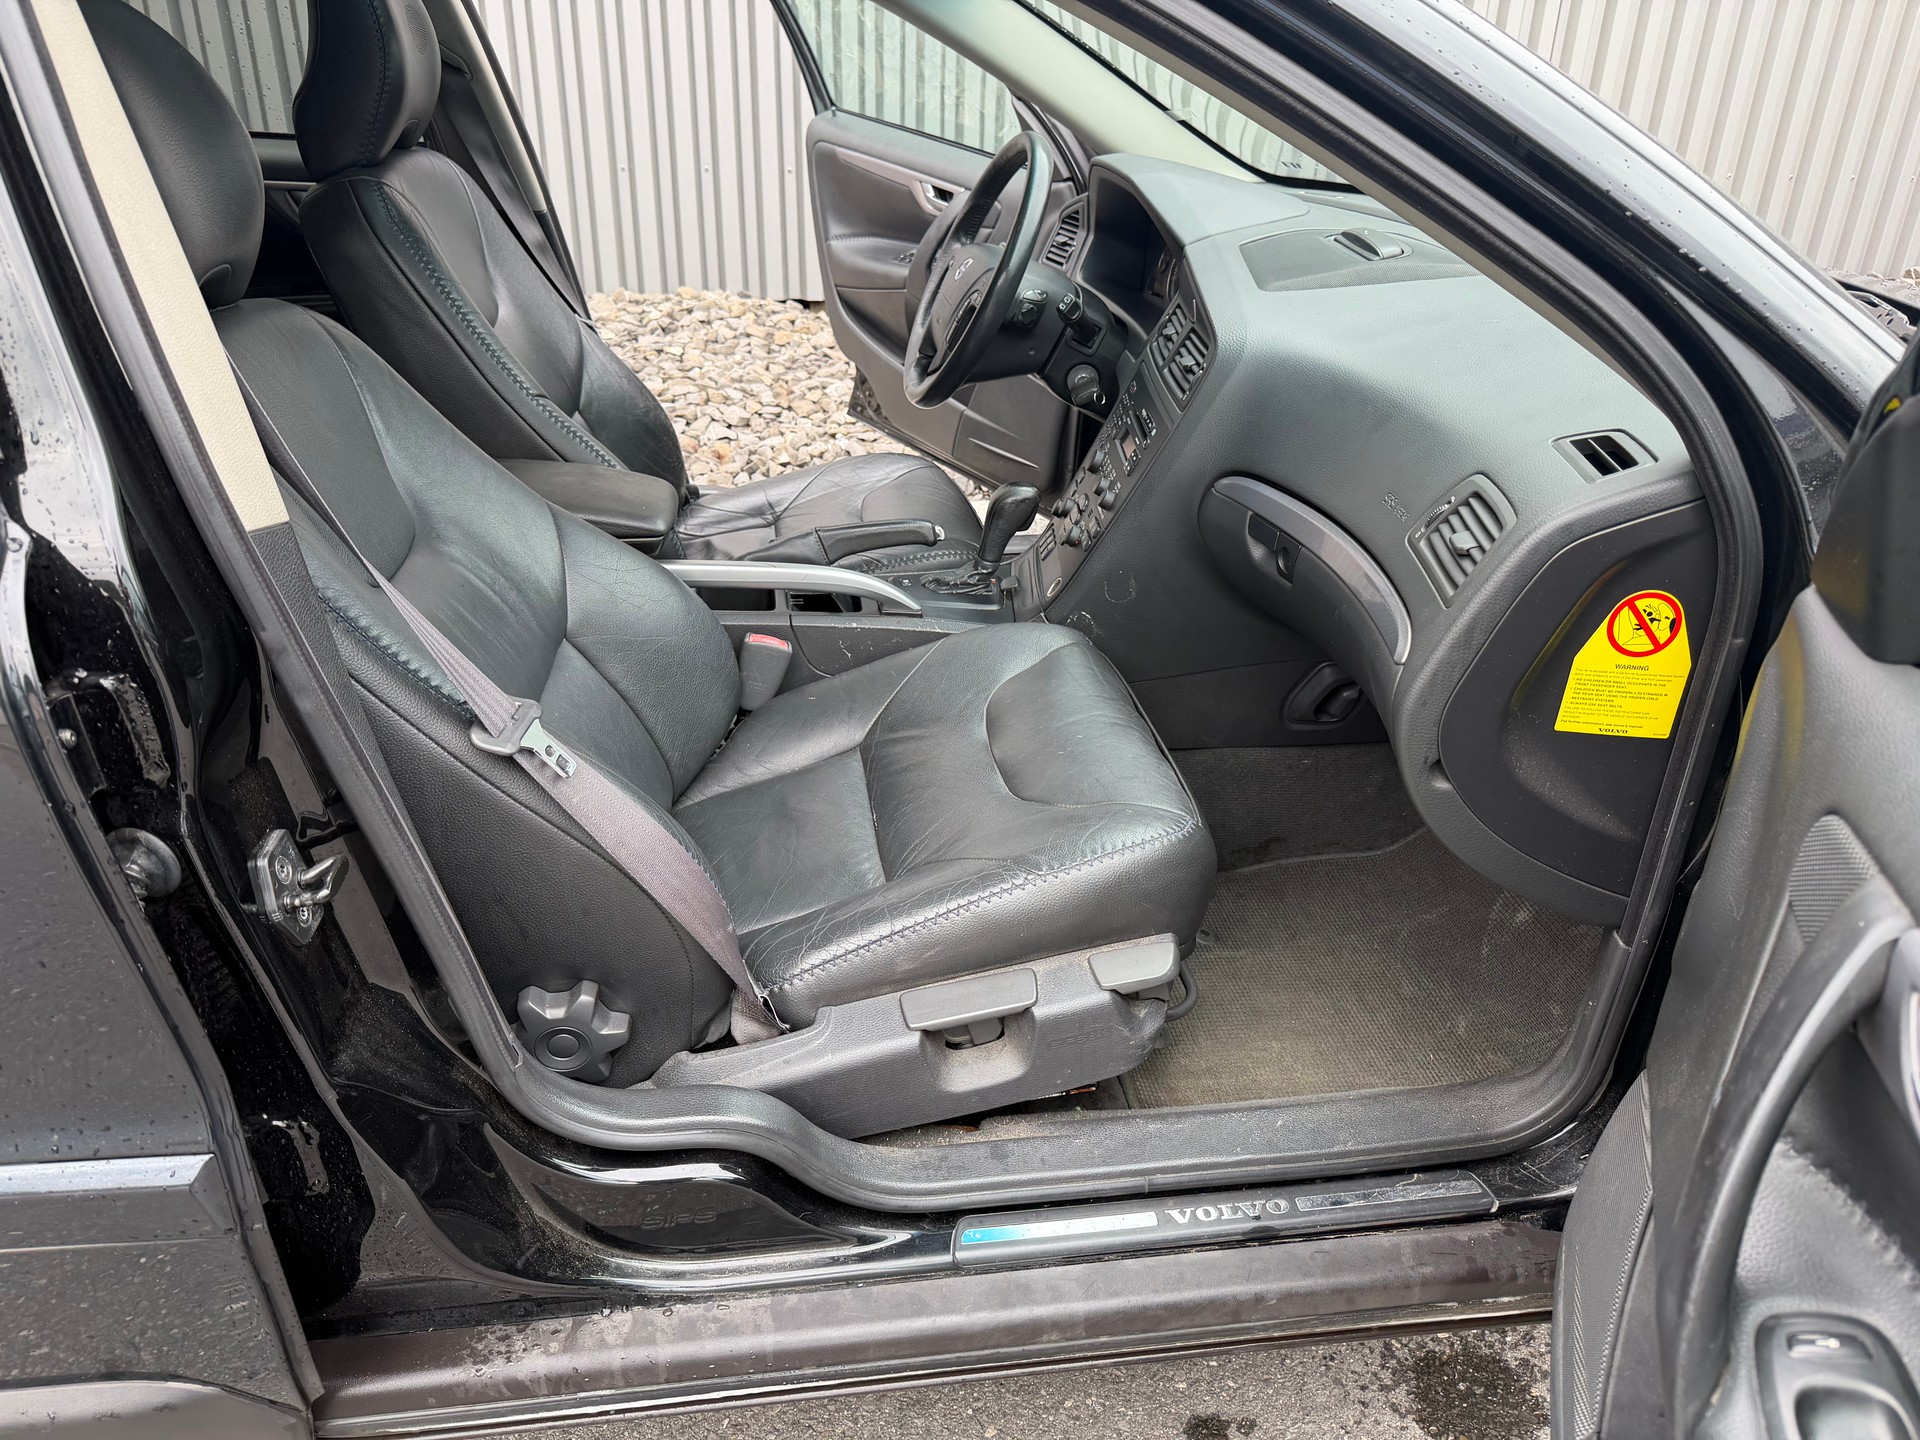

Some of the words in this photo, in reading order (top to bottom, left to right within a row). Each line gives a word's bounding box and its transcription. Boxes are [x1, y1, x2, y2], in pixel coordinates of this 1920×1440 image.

[1615, 663, 1650, 671] WARNING
[640, 1207, 718, 1230] SIPS
[1164, 1198, 1290, 1224] VOLVO
